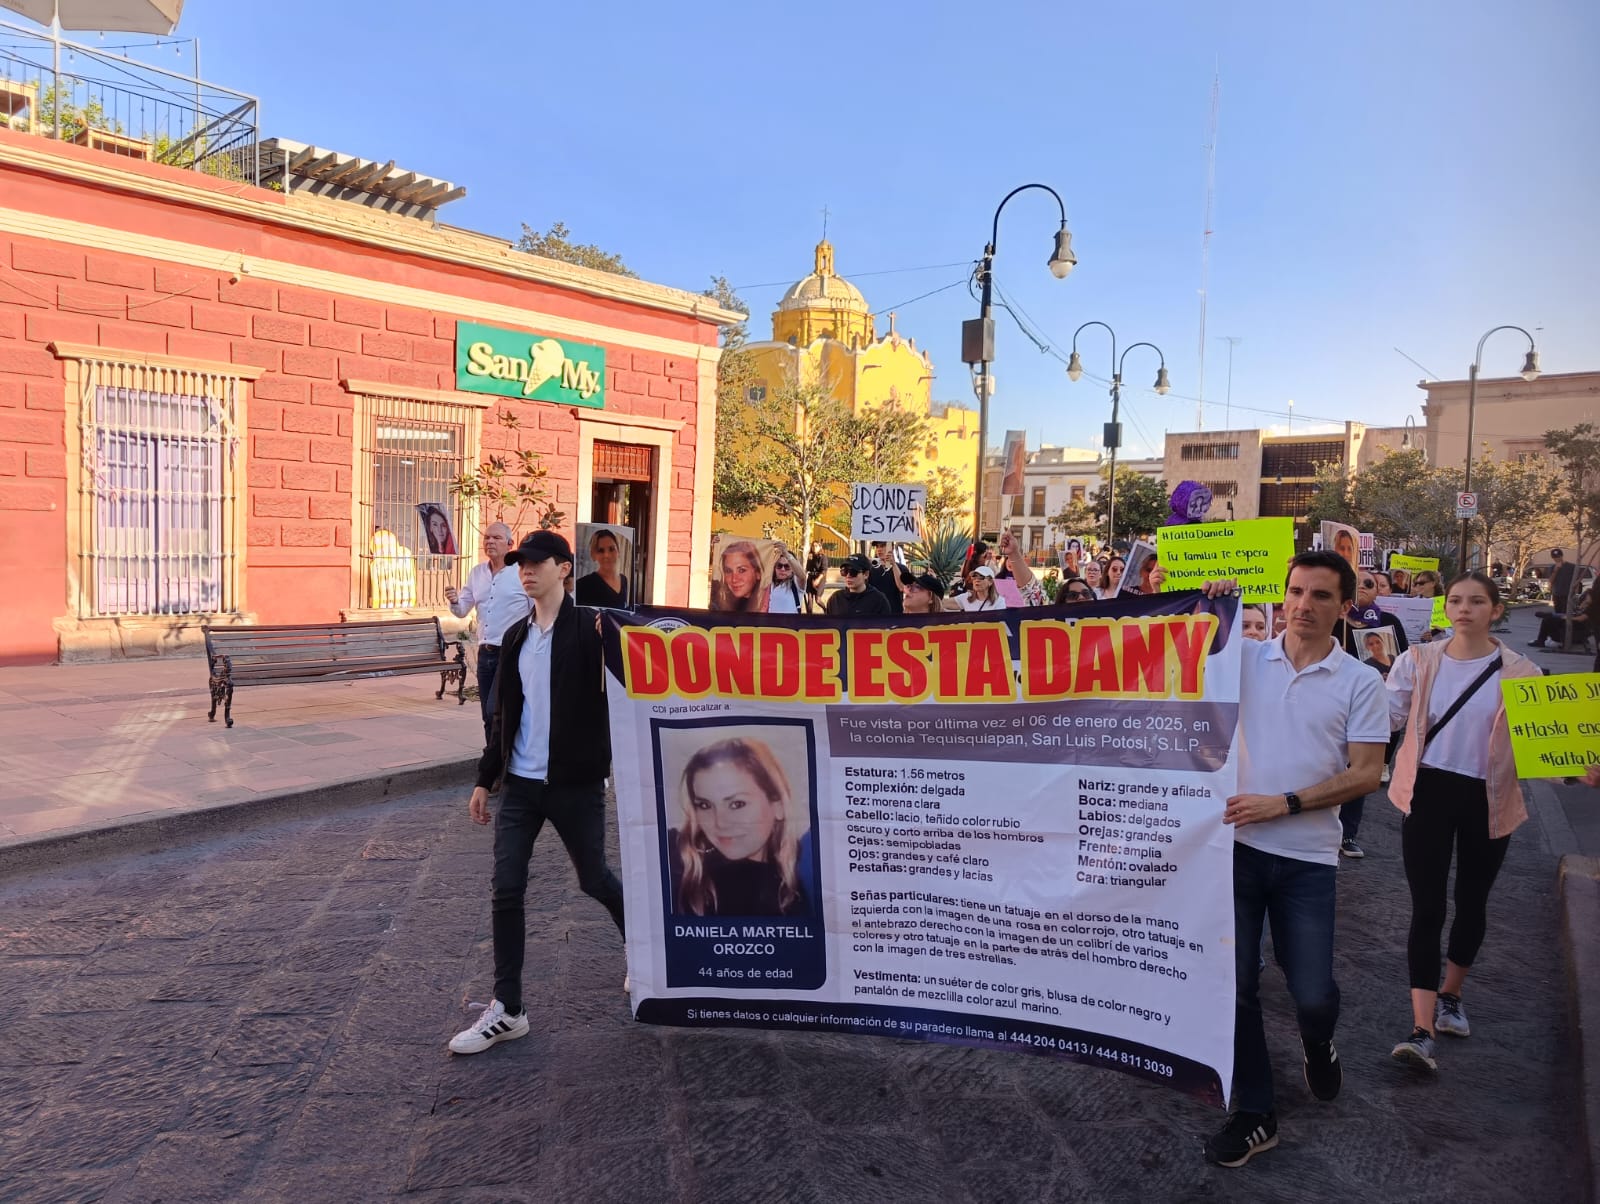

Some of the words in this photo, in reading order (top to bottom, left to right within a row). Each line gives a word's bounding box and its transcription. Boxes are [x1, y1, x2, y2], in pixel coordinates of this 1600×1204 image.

[467, 342, 529, 382] San
[852, 485, 921, 510] ¿DÓNDE
[1167, 551, 1178, 561] Tu
[1184, 551, 1217, 560] familia
[1236, 549, 1268, 562] espera
[1229, 566, 1264, 576] Daniela
[624, 628, 839, 700] DONDE
[850, 624, 1013, 701] ESTA
[1023, 617, 1216, 698] DANY
[1518, 685, 1536, 703] 31
[1546, 682, 1577, 701] DÍAS
[670, 705, 687, 715] para
[689, 704, 720, 712] localizar
[840, 718, 866, 728] Fue
[871, 718, 902, 729] vista
[908, 720, 930, 731] por
[935, 718, 978, 729] última
[983, 719, 1006, 728] vez
[1012, 716, 1024, 727] el
[1029, 715, 1046, 726] 06
[1053, 715, 1070, 727] de
[1075, 716, 1117, 728] enero
[1123, 716, 1141, 729] de
[1146, 717, 1187, 732] 2025,
[1193, 720, 1209, 732] en
[1513, 720, 1568, 737] #Hasta
[850, 732, 861, 742] la
[866, 734, 914, 743] colonia
[920, 734, 1027, 746] Tequisquiapan,
[1032, 733, 1060, 746] San
[1066, 734, 1095, 747] Luis
[845, 767, 897, 777] Estatura:
[901, 768, 924, 778] 1.56
[927, 770, 965, 780] metros
[845, 782, 918, 794] Complexión:
[921, 784, 965, 797] delgada
[1079, 779, 1115, 791] Nariz:
[1118, 783, 1158, 794] grande
[1162, 787, 1168, 797] y
[1172, 785, 1211, 798] afilada
[845, 796, 870, 805] Tez:
[872, 798, 912, 808] morena
[915, 799, 940, 809] clara
[1079, 795, 1116, 807] Boca:
[1119, 799, 1168, 811] mediana
[846, 810, 893, 820] Cabello:
[926, 814, 959, 824] teñido
[963, 816, 990, 826] color
[992, 818, 1020, 828] rubio
[1079, 810, 1126, 823] Labios:
[1129, 814, 1181, 828] delgados
[847, 825, 883, 834] oscuro
[885, 828, 890, 836] y
[893, 828, 920, 836] corto
[923, 829, 953, 837] arriba
[958, 830, 971, 838] de
[975, 831, 990, 839] los
[994, 832, 1044, 842] hombros
[1079, 825, 1123, 839] Orejas:
[1125, 832, 1172, 843] grandes
[848, 835, 883, 847] Cejas:
[887, 840, 961, 850] semipobladas
[1079, 840, 1121, 854] Frente:
[1124, 846, 1161, 859] amplia
[849, 849, 879, 860] Ojos:
[882, 852, 925, 861] grandes
[937, 854, 959, 863] café
[963, 856, 989, 866] claro
[1078, 855, 1126, 870] Mentón:
[1129, 862, 1177, 872] ovalado
[850, 863, 906, 872] Pestañas:
[909, 866, 951, 876] grandes
[954, 870, 960, 880] y
[963, 869, 993, 881] lacias
[1076, 871, 1108, 885] Cara:
[1110, 876, 1166, 888] triangular
[851, 890, 887, 900] Señas
[890, 891, 958, 906] particulares:
[961, 898, 986, 910] tiene
[989, 904, 1000, 912] un
[1005, 905, 1040, 920] tatuaje
[1045, 912, 1059, 920] en
[1063, 912, 1073, 920] el
[1077, 912, 1111, 922] dorso
[1114, 914, 1128, 923] de
[1132, 915, 1141, 924] la
[1146, 917, 1178, 930] mano
[675, 926, 738, 938] DANIELA
[743, 927, 813, 938] MARTELL
[714, 944, 774, 954] OROZCO
[853, 944, 872, 952] con
[875, 943, 883, 952] la
[888, 944, 926, 957] imagen
[929, 947, 943, 956] de
[945, 949, 965, 959] tres
[968, 952, 1016, 965] estrellas.
[699, 968, 712, 976] 44
[717, 968, 744, 978] años
[748, 969, 761, 978] de
[766, 969, 793, 978] edad
[854, 969, 921, 983] Vestimenta:
[924, 976, 936, 984] un
[939, 976, 972, 988] suéter
[975, 980, 988, 990] de
[991, 983, 1018, 994] color
[1047, 988, 1077, 1003] blusa
[1081, 995, 1095, 1005] de
[1098, 1000, 1126, 1012] color
[1129, 1005, 1161, 1021] negro
[1165, 1014, 1171, 1025] y
[855, 985, 898, 996] pantalón
[902, 987, 915, 997] de
[918, 990, 963, 1002] mezclilla
[967, 995, 992, 1006] color
[996, 998, 1016, 1008] azul
[1022, 1002, 1061, 1015] marino.
[688, 1009, 697, 1018] Si
[700, 1010, 730, 1019] tienes
[734, 1010, 760, 1020] datos
[773, 1013, 818, 1024] cualquier
[821, 1014, 881, 1026] información
[884, 1018, 897, 1028] de
[900, 1021, 912, 1029] su
[915, 1022, 962, 1035] paradero
[966, 1027, 993, 1040] llama
[998, 1027, 1006, 1041] al
[1011, 1032, 1031, 1044] 444
[1034, 1035, 1055, 1048] 204
[1059, 1040, 1087, 1054] 0413
[1096, 1048, 1118, 1061] 444
[1121, 1053, 1140, 1067] 811
[1144, 1057, 1172, 1077] 3039
